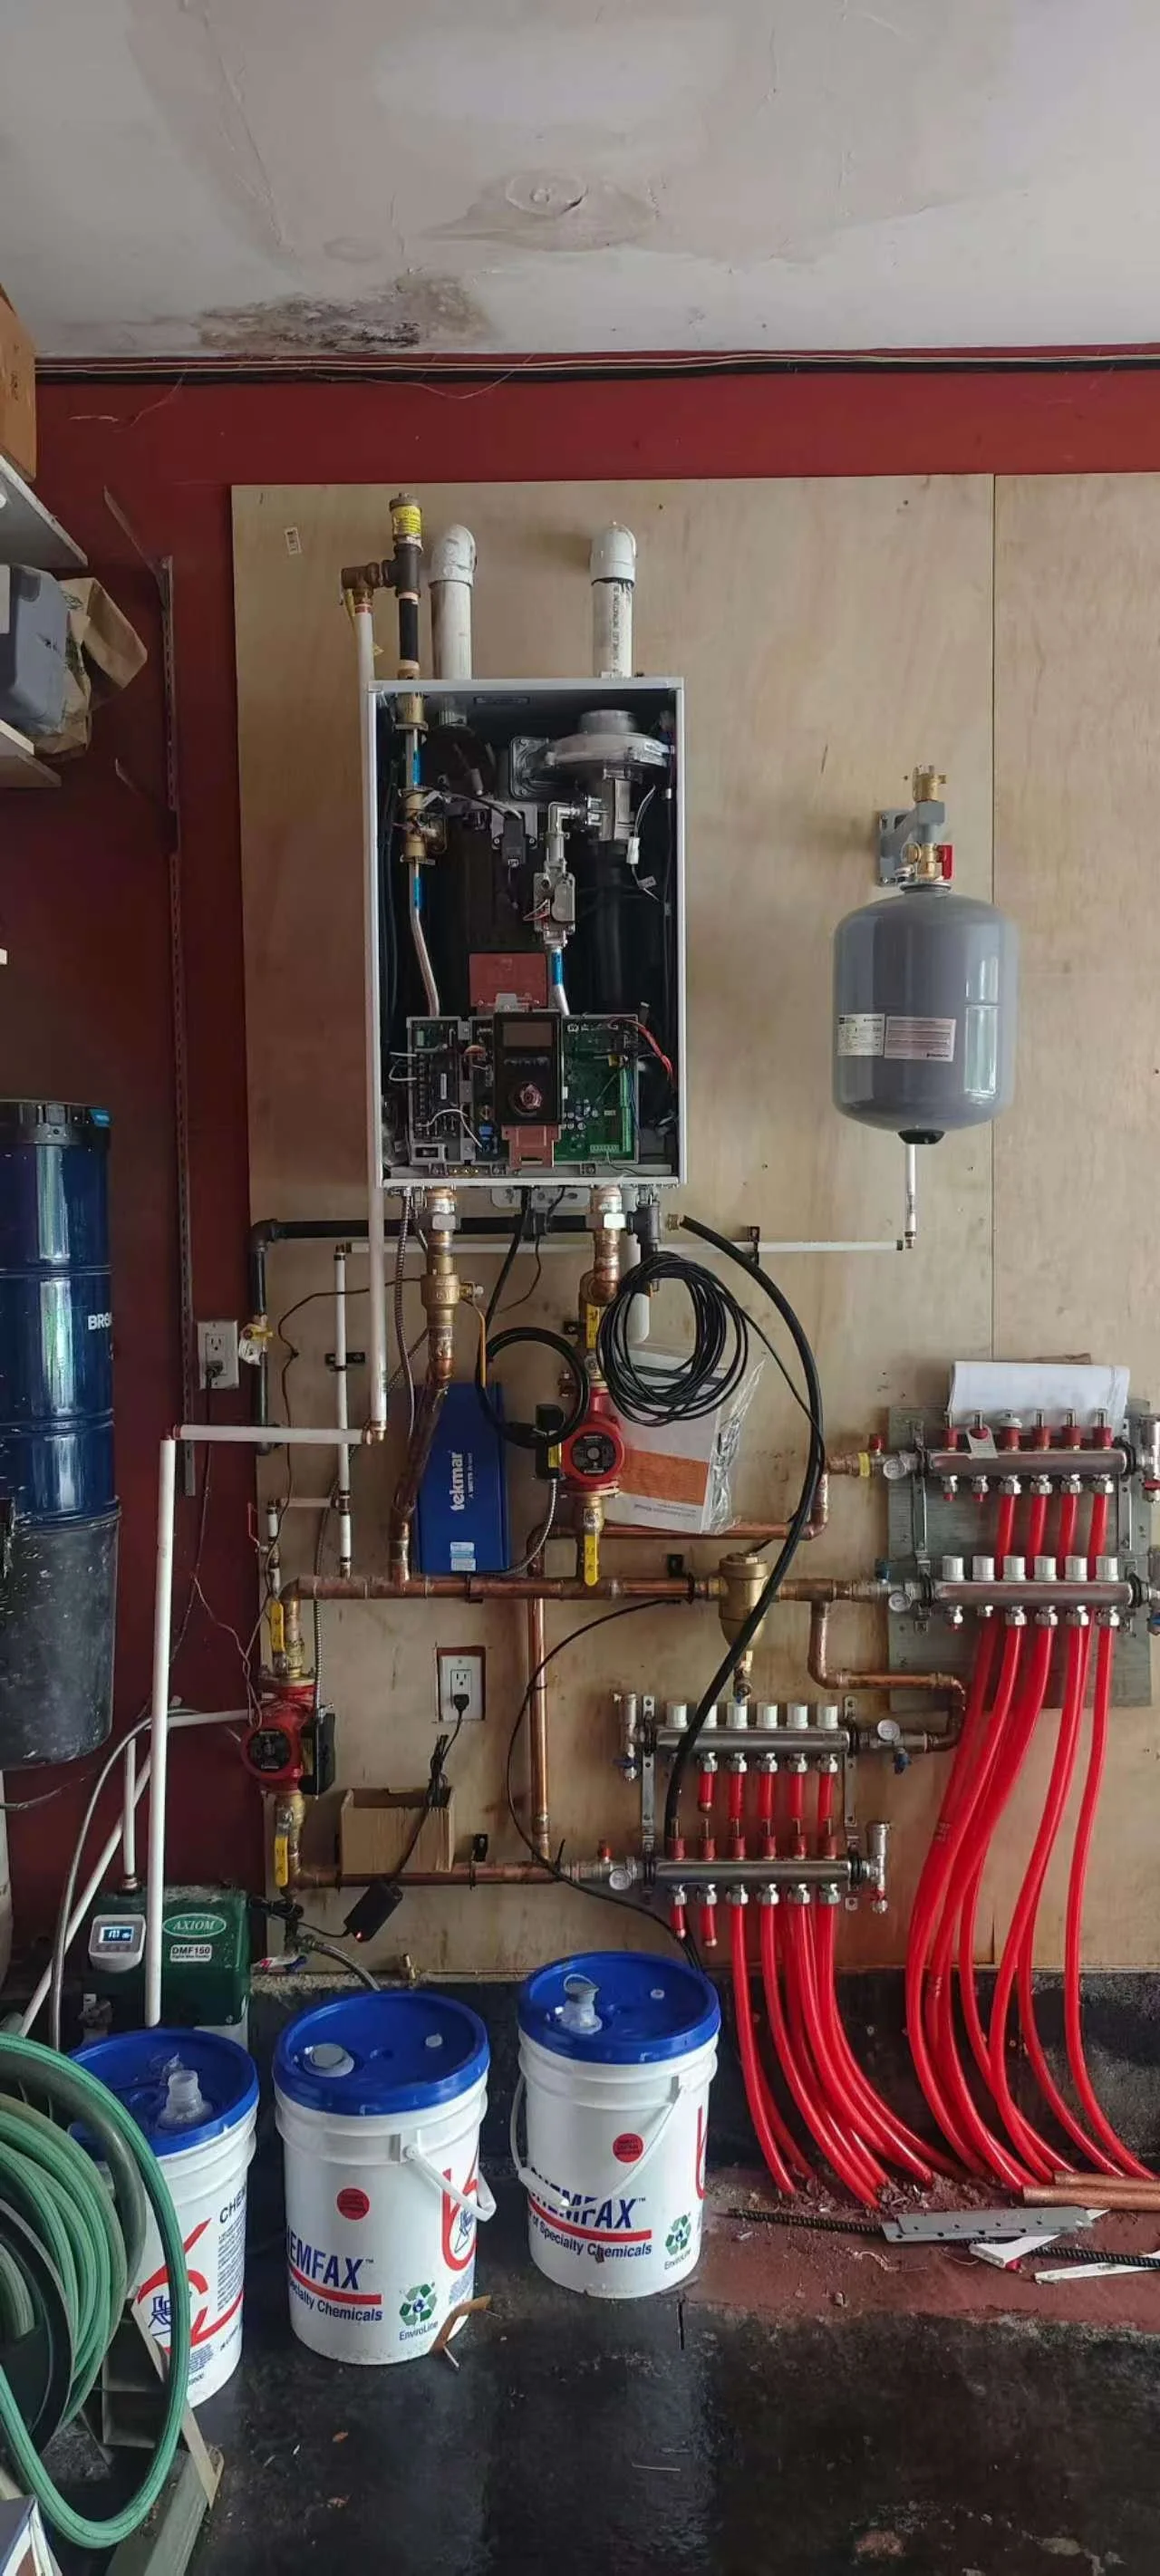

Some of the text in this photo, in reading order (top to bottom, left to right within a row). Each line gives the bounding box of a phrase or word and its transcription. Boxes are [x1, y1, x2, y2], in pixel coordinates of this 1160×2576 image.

[450, 1452, 465, 1510] tekmar
[173, 1920, 216, 1931] AXIOM
[172, 1946, 210, 1954] DMF150
[539, 2220, 585, 2256] Specialty
[587, 2242, 652, 2259] Chemicals
[287, 2225, 363, 2291] EMFAX
[317, 2300, 383, 2321] Chemicals
